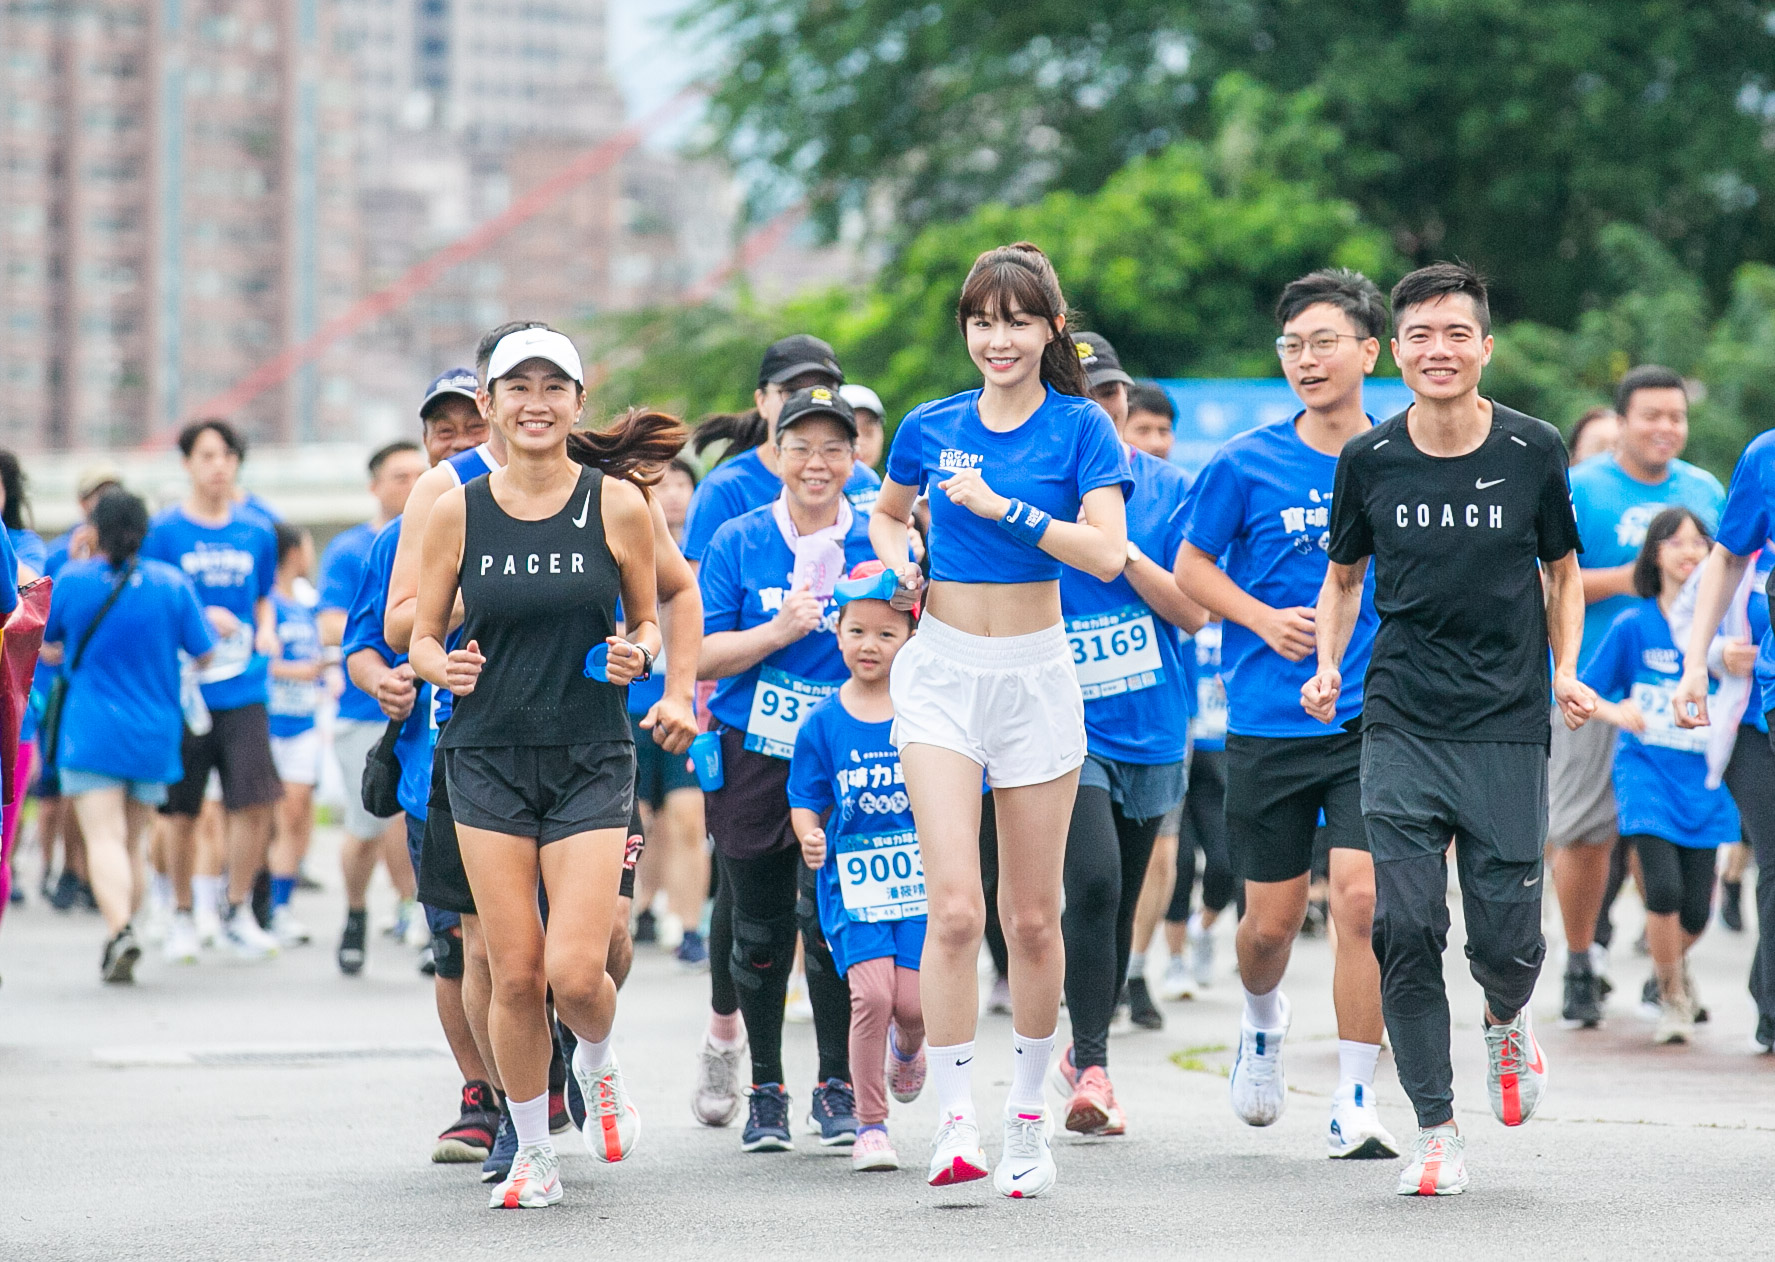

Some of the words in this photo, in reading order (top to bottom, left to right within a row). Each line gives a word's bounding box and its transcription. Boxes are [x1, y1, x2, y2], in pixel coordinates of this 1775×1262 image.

[939, 451, 984, 463] POCARI
[939, 459, 976, 468] SWEAT
[1396, 503, 1503, 528] COACH
[480, 553, 585, 576] PACER
[1069, 624, 1147, 664] 3169
[761, 690, 817, 722] 93
